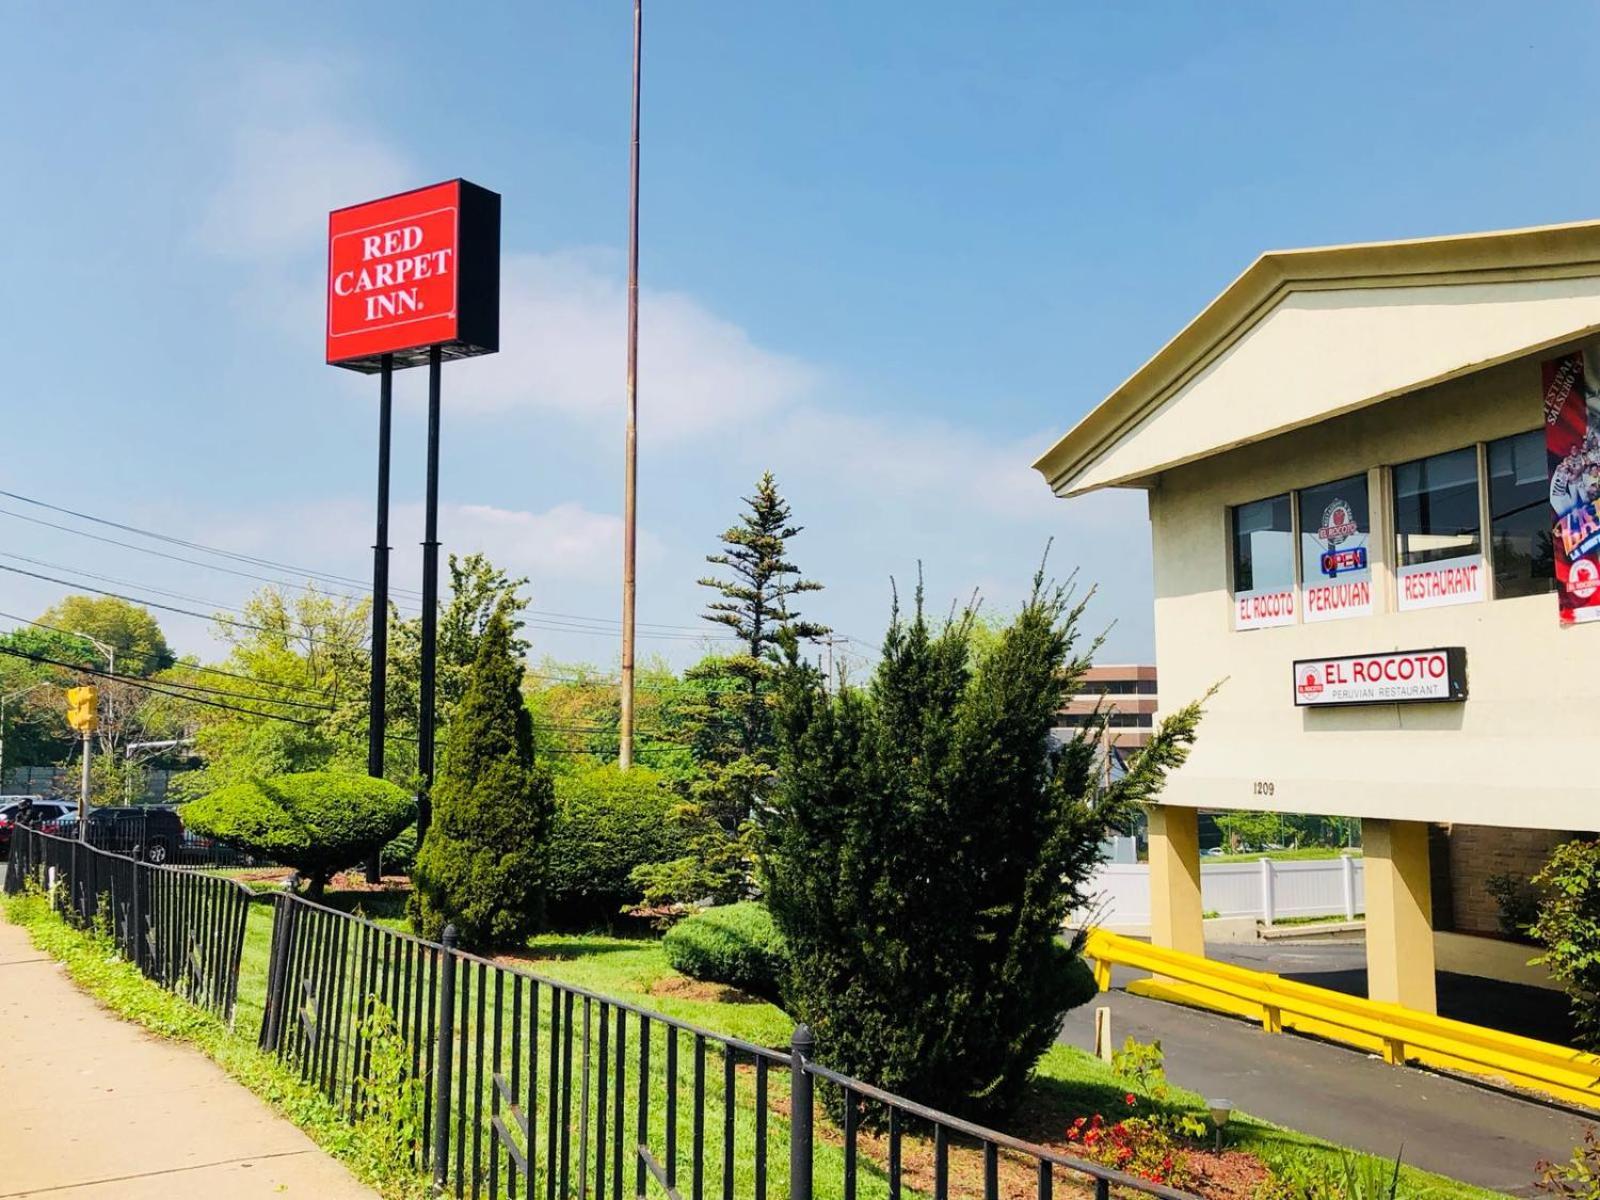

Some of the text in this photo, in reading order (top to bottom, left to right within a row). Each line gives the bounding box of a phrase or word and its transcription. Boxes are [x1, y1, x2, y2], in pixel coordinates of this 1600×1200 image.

[363, 226, 423, 261] RED
[334, 248, 452, 296] CARPET
[1323, 549, 1363, 571] OPEN
[1309, 582, 1369, 612] PERUVIAN
[1405, 565, 1477, 600] RESTAURANT
[1240, 592, 1294, 620] EL ROCOTO
[1325, 655, 1445, 684] EL ROCOTO
[1332, 687, 1375, 700] PERUVIAN
[1378, 684, 1439, 697] RESTAURANT
[1253, 781, 1275, 796] 1209
